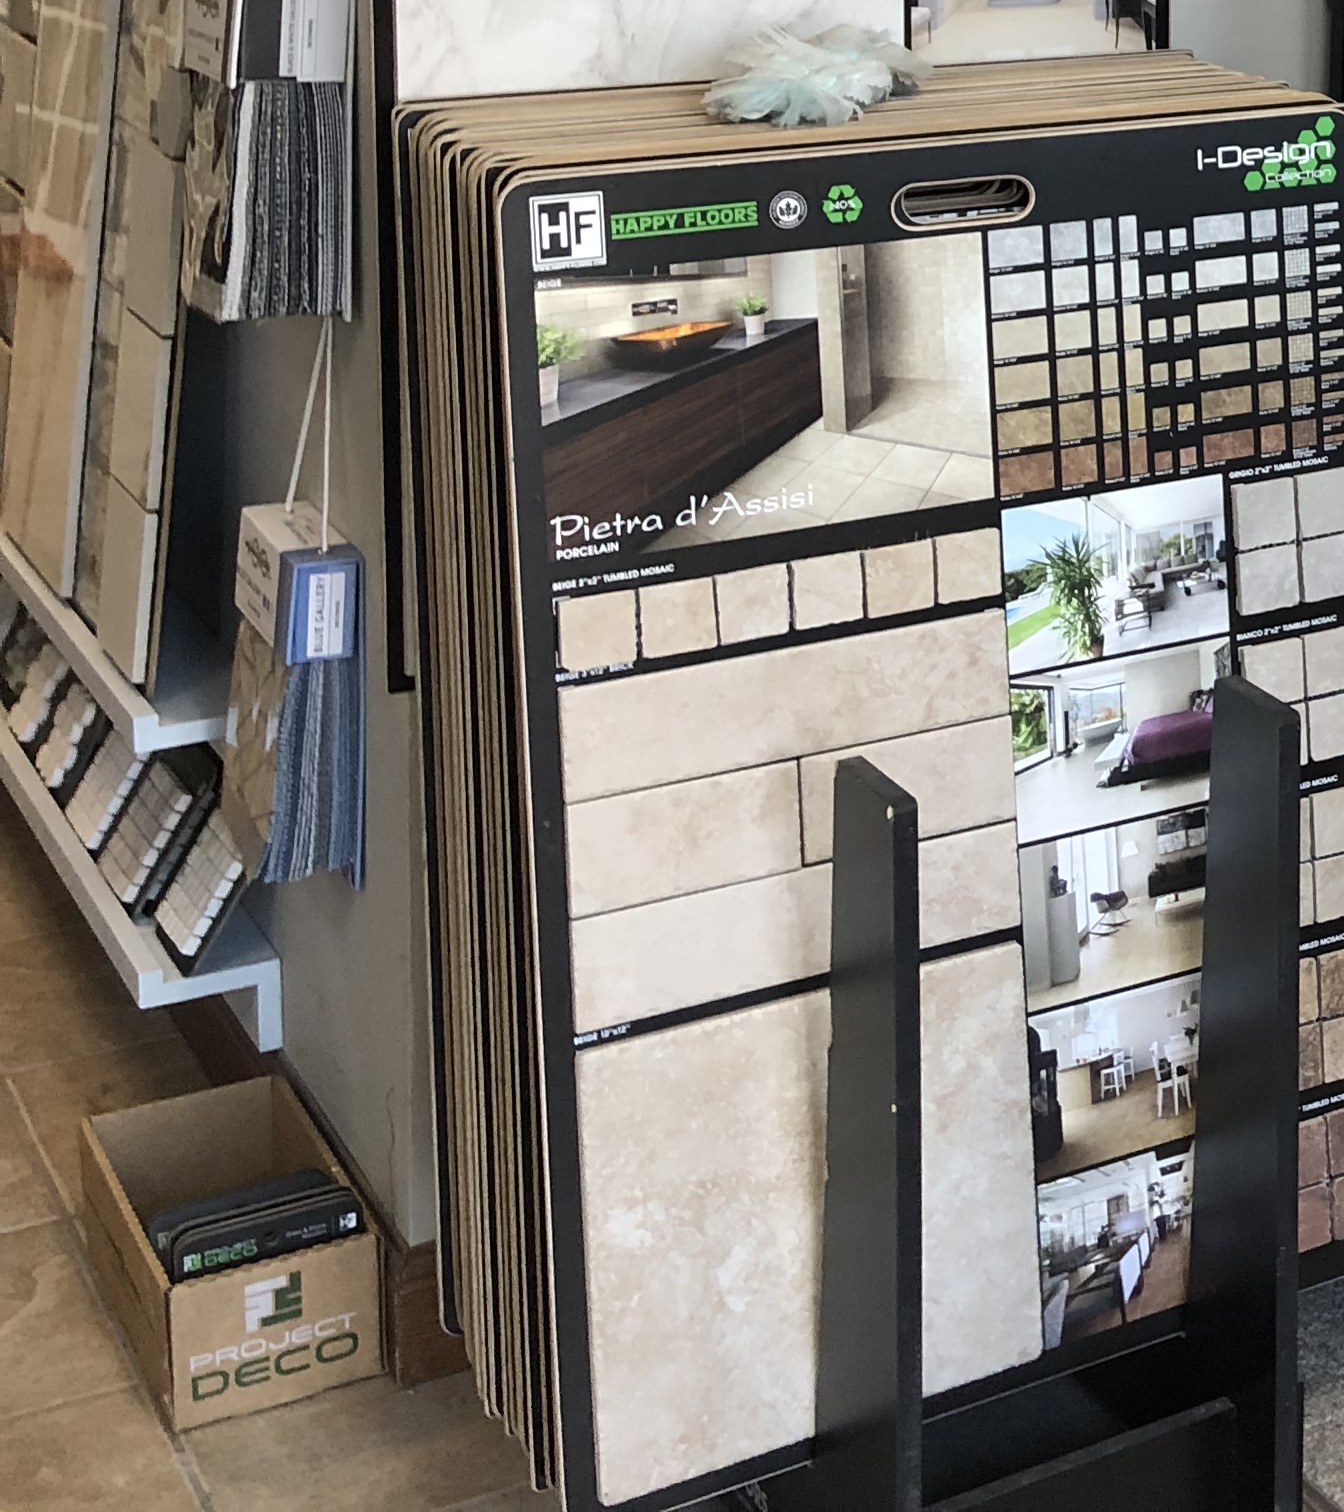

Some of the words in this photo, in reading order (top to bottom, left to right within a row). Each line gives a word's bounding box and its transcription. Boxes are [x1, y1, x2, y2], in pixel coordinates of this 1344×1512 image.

[1196, 140, 1332, 172] I-Design
[1264, 165, 1332, 184] Collection
[611, 213, 678, 236] HAPPY
[684, 204, 759, 228] FLOORS
[1228, 468, 1254, 480] GRIGIO
[1302, 455, 1329, 467] MOSAIC
[550, 511, 664, 546] Pietra
[675, 483, 815, 527] d'Assisi
[555, 541, 620, 561] PORCELAIN
[602, 568, 640, 584] TUMBLED
[640, 563, 675, 577] MOSAIC
[1310, 613, 1338, 628] MOSAIC
[1311, 774, 1339, 787] MOSAIC
[189, 1311, 358, 1372] PROJECT
[190, 1331, 360, 1403] DECO
